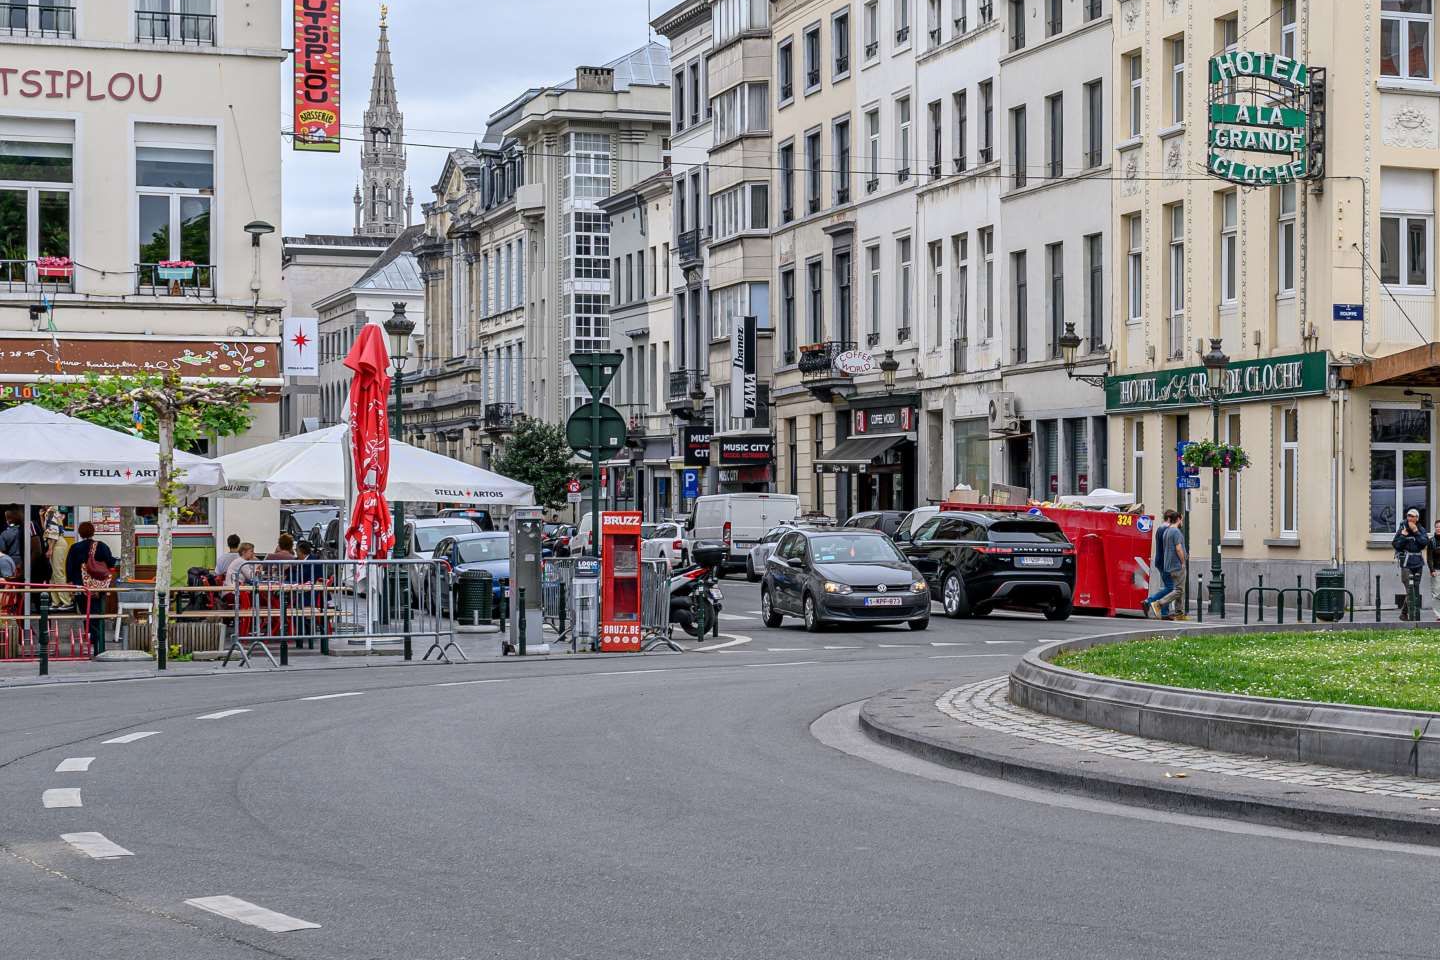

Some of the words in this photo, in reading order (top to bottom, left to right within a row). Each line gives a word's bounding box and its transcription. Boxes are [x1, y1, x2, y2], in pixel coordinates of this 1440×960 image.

[1215, 51, 1305, 89] HOTEL
[0, 67, 162, 102] TSIPLOU
[1256, 105, 1284, 126] LA
[1215, 128, 1303, 153] GRANDE
[1213, 156, 1303, 184] CLOCHE
[733, 326, 744, 370] Ibanez
[839, 351, 872, 362] COFFEE
[841, 362, 871, 373] WORLD
[1119, 378, 1159, 404] HOTEL
[1189, 369, 1242, 397] GRDE
[1245, 361, 1304, 392] CLOCHE
[744, 373, 757, 411] TAMA
[690, 434, 711, 443] MUS
[694, 449, 710, 458] CIT
[723, 443, 749, 452] MUSIC
[750, 444, 770, 452] CITY
[79, 469, 121, 478] STELLA
[135, 469, 159, 478] ART
[685, 472, 696, 488] P
[434, 488, 464, 497] STELLA
[473, 490, 504, 498] ARTOIS
[603, 515, 641, 526] BRUZZ
[1116, 514, 1133, 526] 324
[603, 624, 640, 635] BRUZZ.BE
